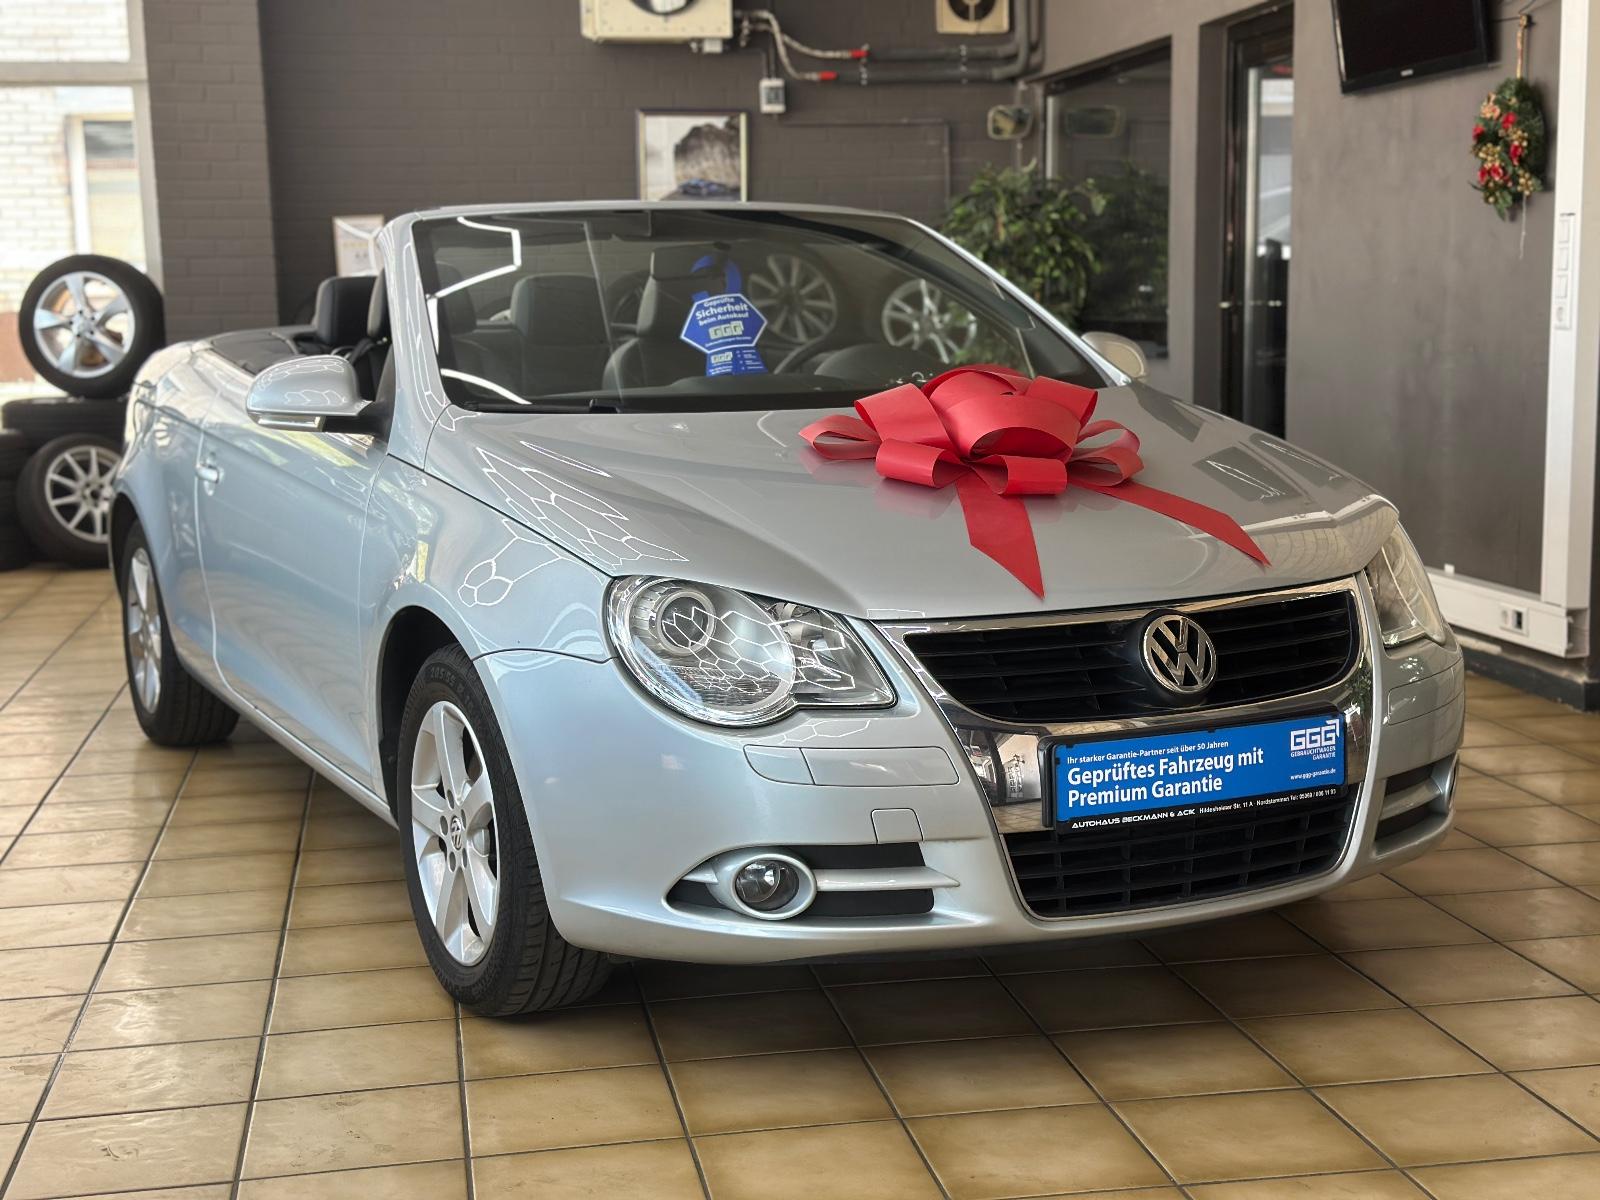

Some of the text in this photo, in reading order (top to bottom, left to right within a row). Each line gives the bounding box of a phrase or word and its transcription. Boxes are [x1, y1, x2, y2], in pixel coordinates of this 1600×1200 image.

[695, 303, 749, 320] Sicherheit
[698, 311, 749, 327] beim Autokauf
[708, 320, 744, 340] GGG
[1290, 724, 1337, 751] GGG
[1067, 740, 1229, 765] Ihr starker Garantie-Partner seit über 50 Jahren
[1312, 752, 1336, 761] GARANTIE
[1067, 746, 1264, 787] Geprüftes Fahrzeug mit
[1068, 774, 1223, 808] Premium Garantie
[1071, 818, 1121, 829] AUTOHAUS
[1121, 811, 1169, 824] BECKMANN
[1232, 802, 1242, 810] Str.
